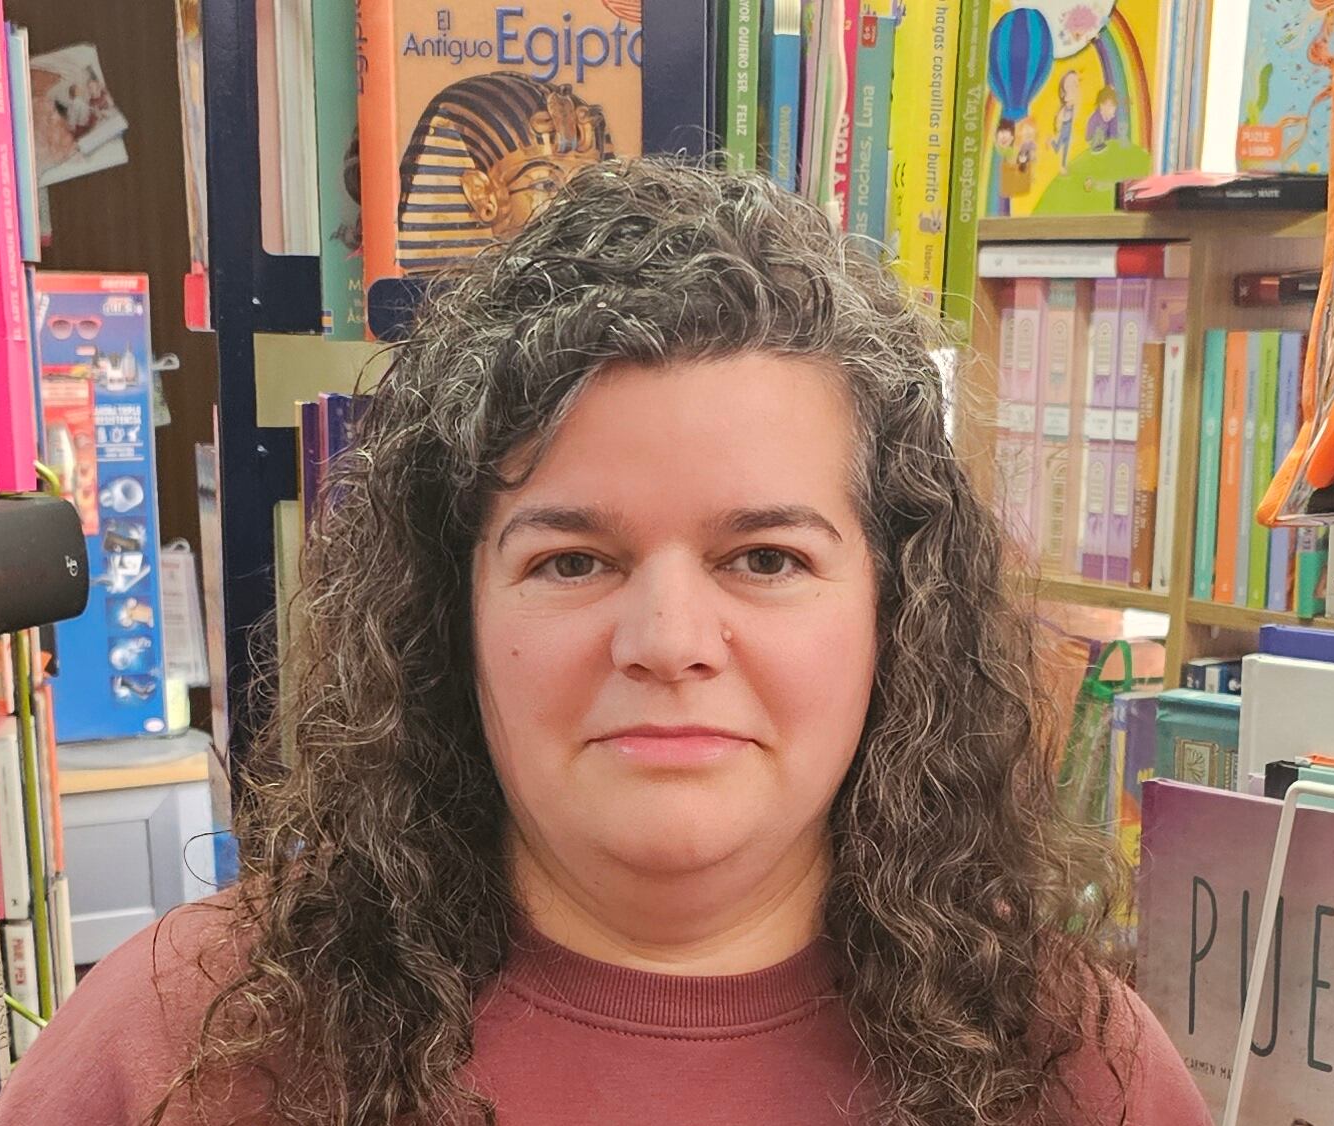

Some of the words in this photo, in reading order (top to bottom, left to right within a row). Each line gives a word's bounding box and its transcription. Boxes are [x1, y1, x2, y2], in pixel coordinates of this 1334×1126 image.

[437, 9, 451, 32] El
[931, 6, 949, 51] hagas
[736, 26, 751, 69] QUIERO
[736, 70, 750, 93] SER
[927, 55, 947, 129] cosquillas
[736, 103, 748, 137] FELIZ
[927, 132, 943, 149] al
[924, 151, 942, 203] burrito
[1183, 1056, 1217, 1078] CARMEN
